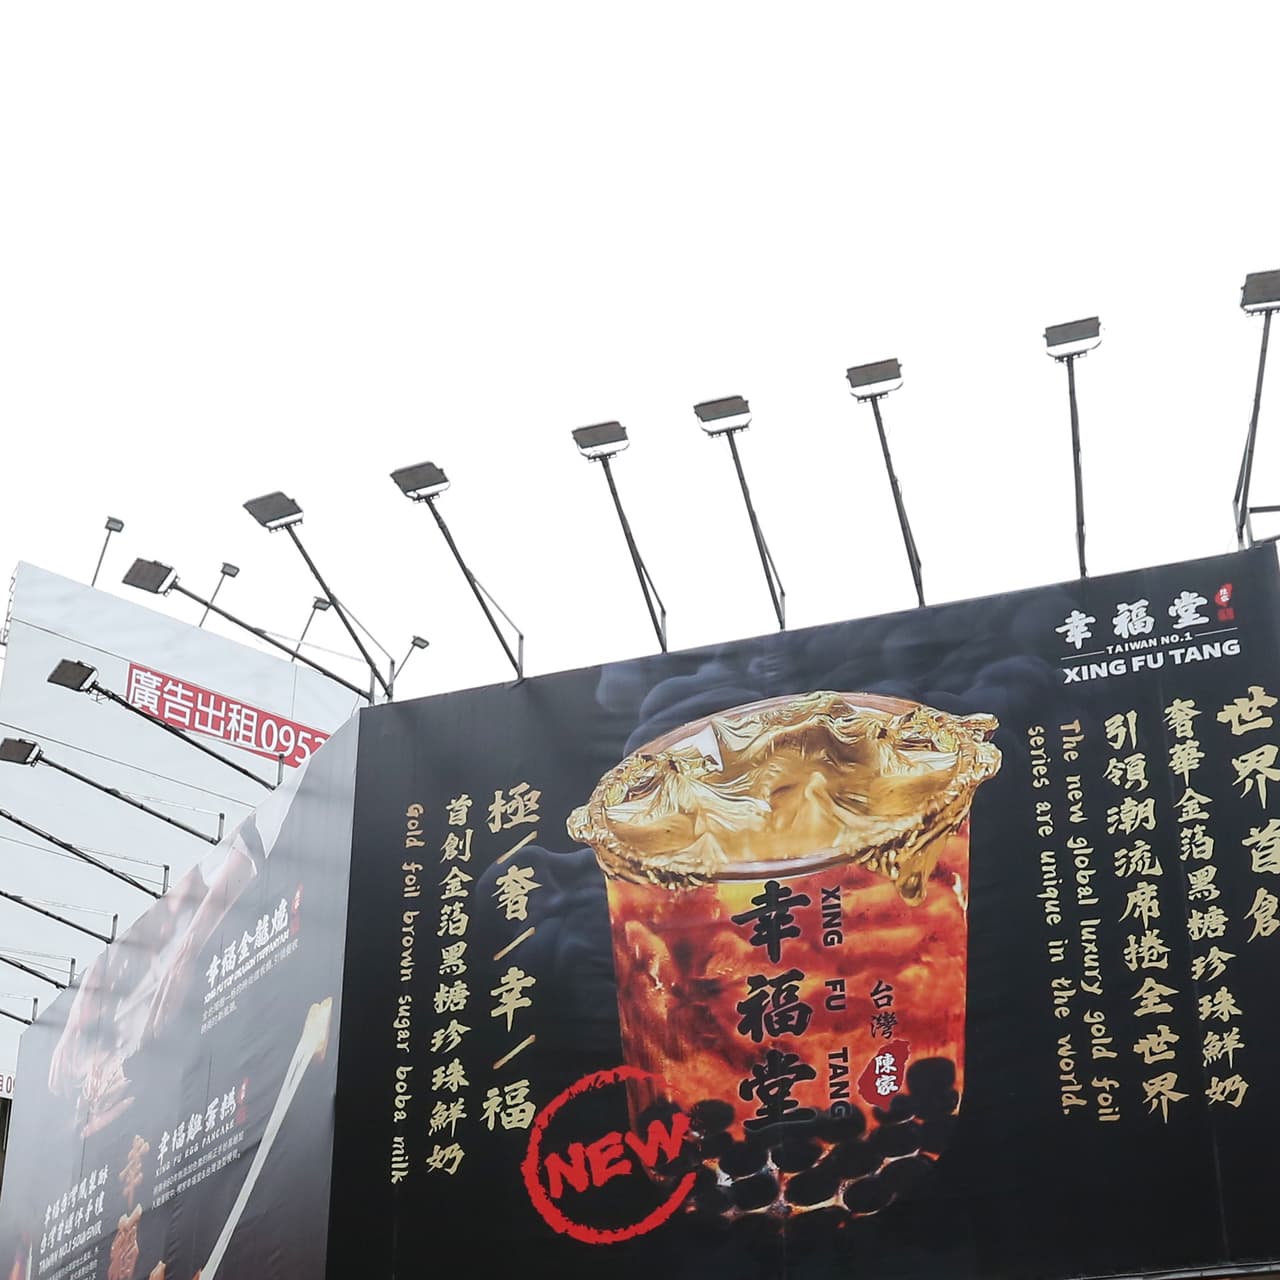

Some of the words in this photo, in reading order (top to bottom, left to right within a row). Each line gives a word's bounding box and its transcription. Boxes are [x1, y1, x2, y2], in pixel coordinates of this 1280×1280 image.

[1055, 591, 1209, 649] 幸福堂
[1106, 637, 1158, 655] TAIWAN
[1161, 632, 1193, 645] NO.1
[1063, 659, 1127, 684] XING
[1131, 654, 1164, 672] FU
[1169, 639, 1241, 665] TANG
[1027, 725, 1050, 788] series
[1060, 719, 1084, 762] The
[405, 804, 424, 848] Gold
[1036, 801, 1054, 837] are
[1064, 774, 1088, 823] new
[401, 862, 423, 898] foil
[1036, 850, 1064, 926] unique
[1066, 835, 1099, 906] global
[820, 886, 843, 948] XING
[1104, 710, 1189, 1125] 引領潮流席捲全世界
[1163, 697, 1249, 1113] 奢華金箔黑糖珍珠鮮奶
[397, 910, 423, 982] brown
[1047, 938, 1069, 963] in
[1079, 918, 1103, 996] luxury
[426, 793, 473, 1176] 首創金箔黑糖珍珠鮮奶
[731, 878, 817, 1133] 幸福堂
[822, 979, 847, 1013] FU
[870, 980, 898, 1039] 台灣
[1050, 976, 1077, 1019] the
[393, 995, 412, 1051] sugar
[1083, 1008, 1118, 1059] gold
[393, 1065, 413, 1122] boba
[824, 1046, 855, 1122] TANG
[1056, 1033, 1087, 1116] world.
[1091, 1076, 1120, 1122] foil
[391, 1136, 409, 1184] milk
[542, 1111, 690, 1201] NEW
